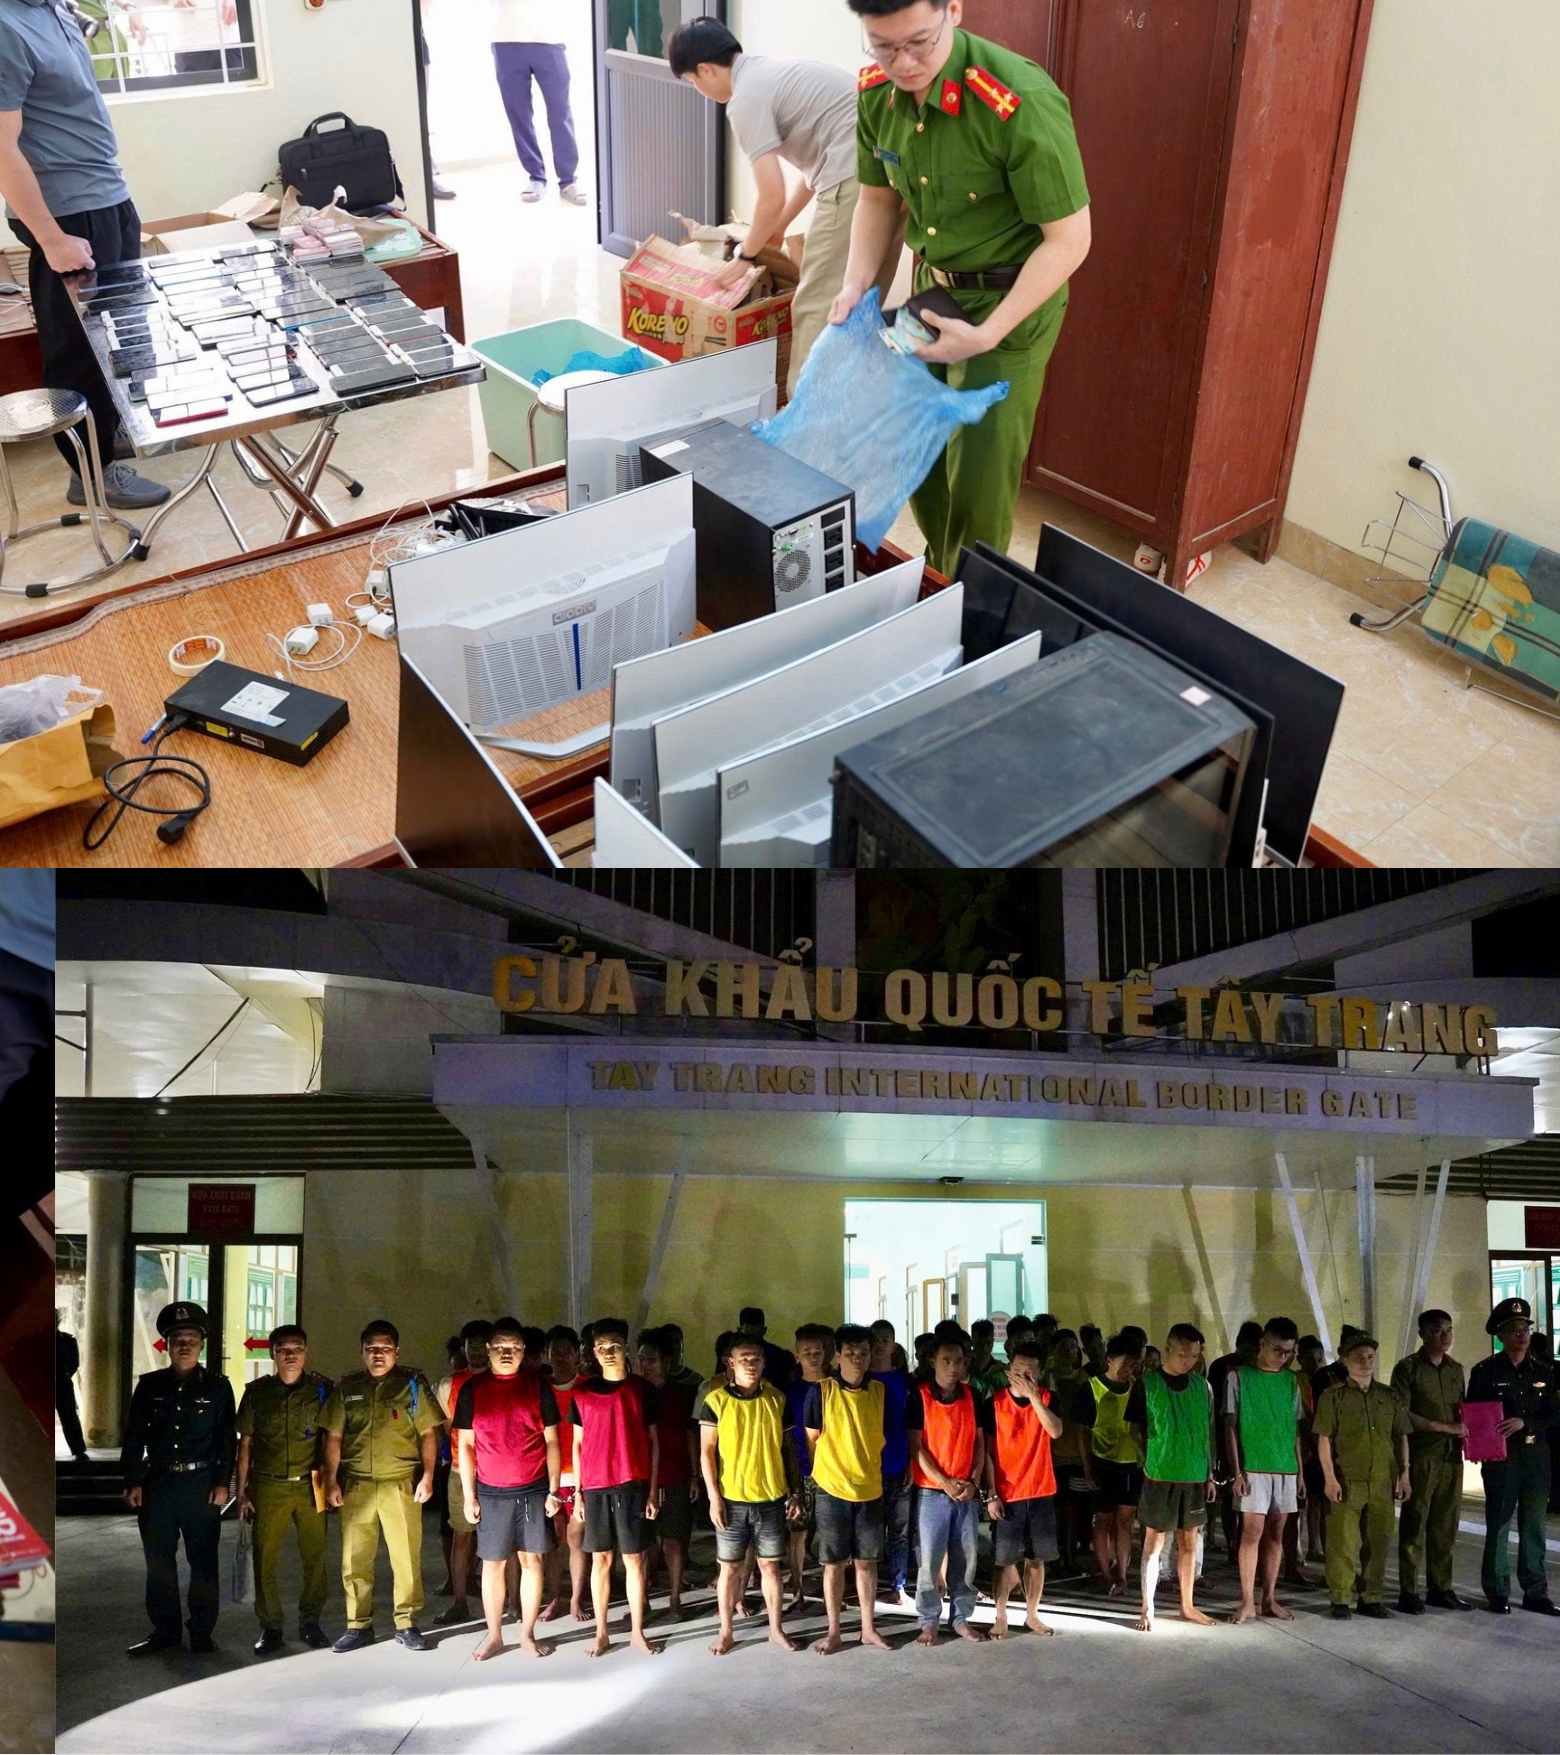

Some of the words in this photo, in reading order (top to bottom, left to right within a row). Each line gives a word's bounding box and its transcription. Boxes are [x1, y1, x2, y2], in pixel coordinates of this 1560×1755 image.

[492, 935, 637, 1014] CỬA
[665, 937, 858, 1022] KHẨU
[884, 953, 1062, 1031] QUỐC
[1082, 963, 1160, 1037] TẾ
[1176, 974, 1286, 1045] TÂY
[1305, 996, 1499, 1056] TRANG
[587, 1061, 659, 1091] TAY
[669, 1063, 815, 1095] TRANG
[825, 1067, 1146, 1107] INTERNATIONAL
[1157, 1081, 1308, 1114] BORDER
[1321, 1090, 1417, 1120] GATE
